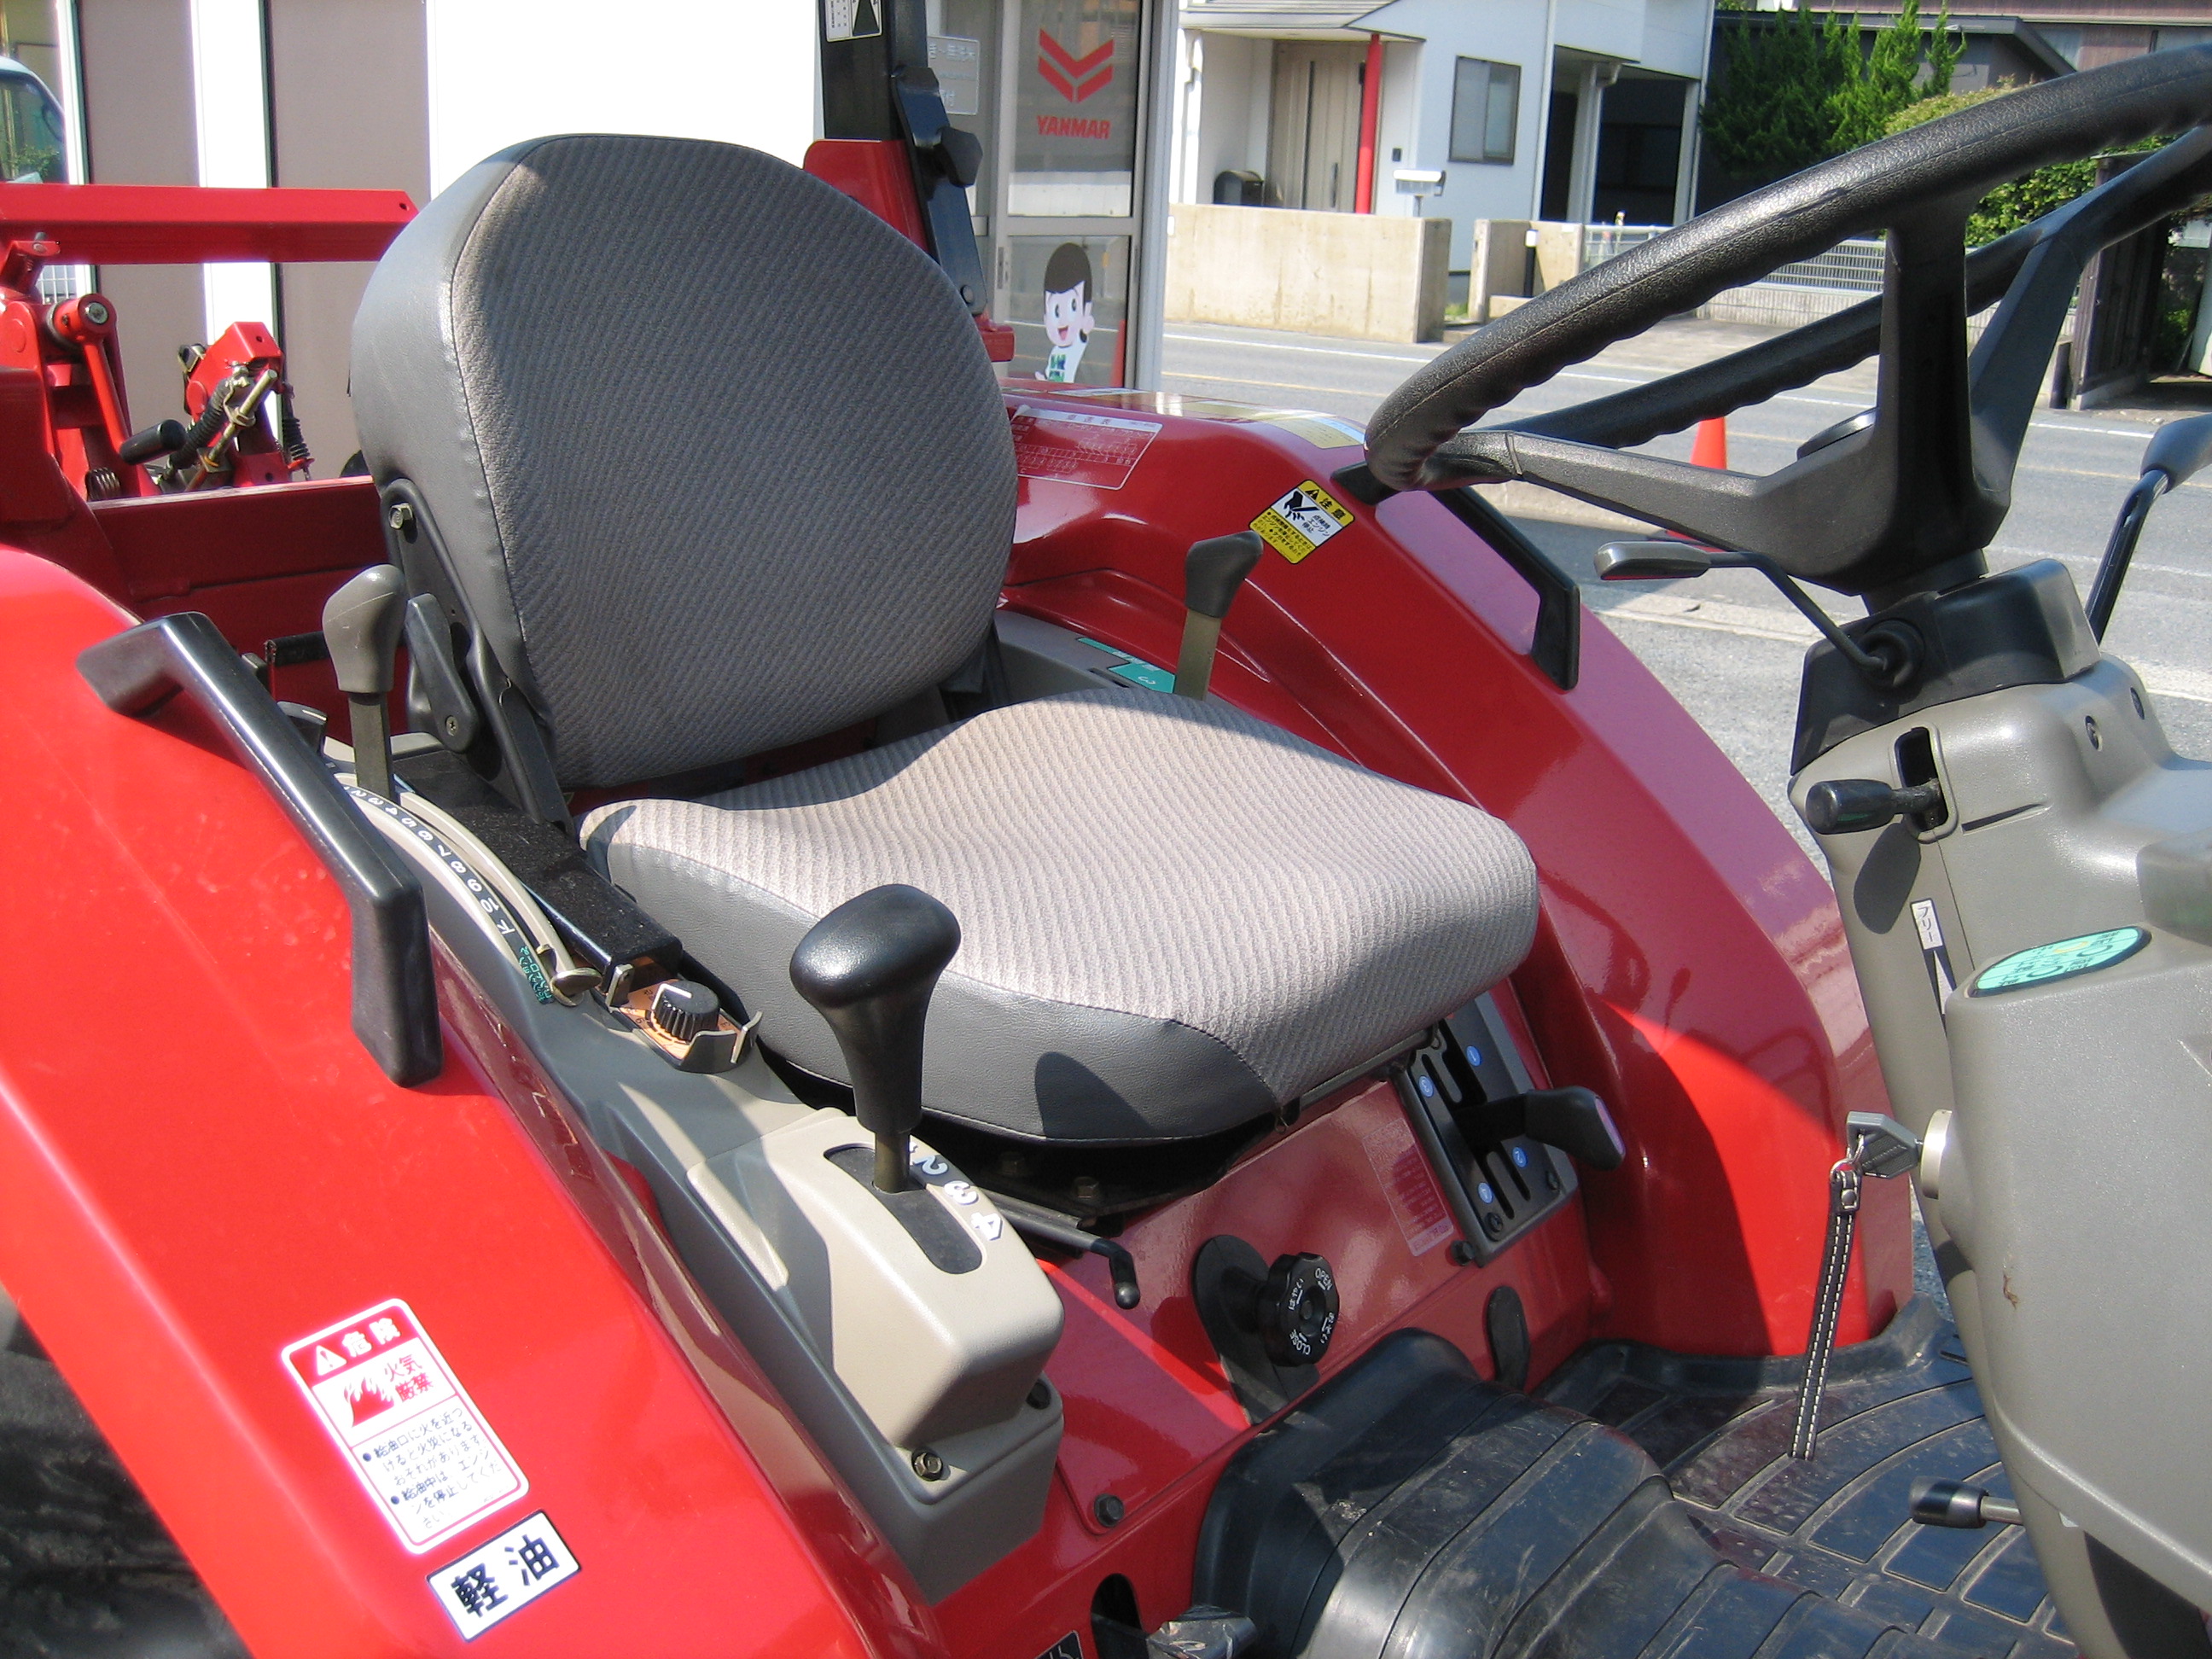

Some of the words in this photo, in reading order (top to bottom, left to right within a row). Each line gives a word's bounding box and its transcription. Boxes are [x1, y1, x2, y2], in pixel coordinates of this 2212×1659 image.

[1036, 114, 1112, 140] YANMAR
[1318, 498, 1346, 520] 注意
[1138, 676, 1156, 685] 3
[368, 797, 384, 806] 3
[385, 806, 399, 816] 4
[401, 817, 417, 828] 5
[417, 830, 434, 841] 6
[437, 844, 451, 858] 7
[451, 860, 467, 874] 8
[466, 878, 482, 893] 9
[480, 896, 499, 914] 10
[1917, 905, 1934, 943] フリー
[520, 946, 552, 998] コントロール
[912, 1155, 949, 1176] 2
[944, 1180, 979, 1206] 3
[970, 1212, 1003, 1241] 4
[1288, 1278, 1304, 1311] はやい
[1314, 1267, 1334, 1291] OPEN
[341, 1317, 401, 1358] 危険
[1289, 1329, 1311, 1355] CLOSE
[384, 1353, 422, 1382] 火気
[394, 1371, 434, 1403] 厳禁
[382, 1419, 474, 1473] けると火災になる
[411, 1460, 502, 1515] ンを停止してくだ
[451, 1534, 560, 1618] 軽油
